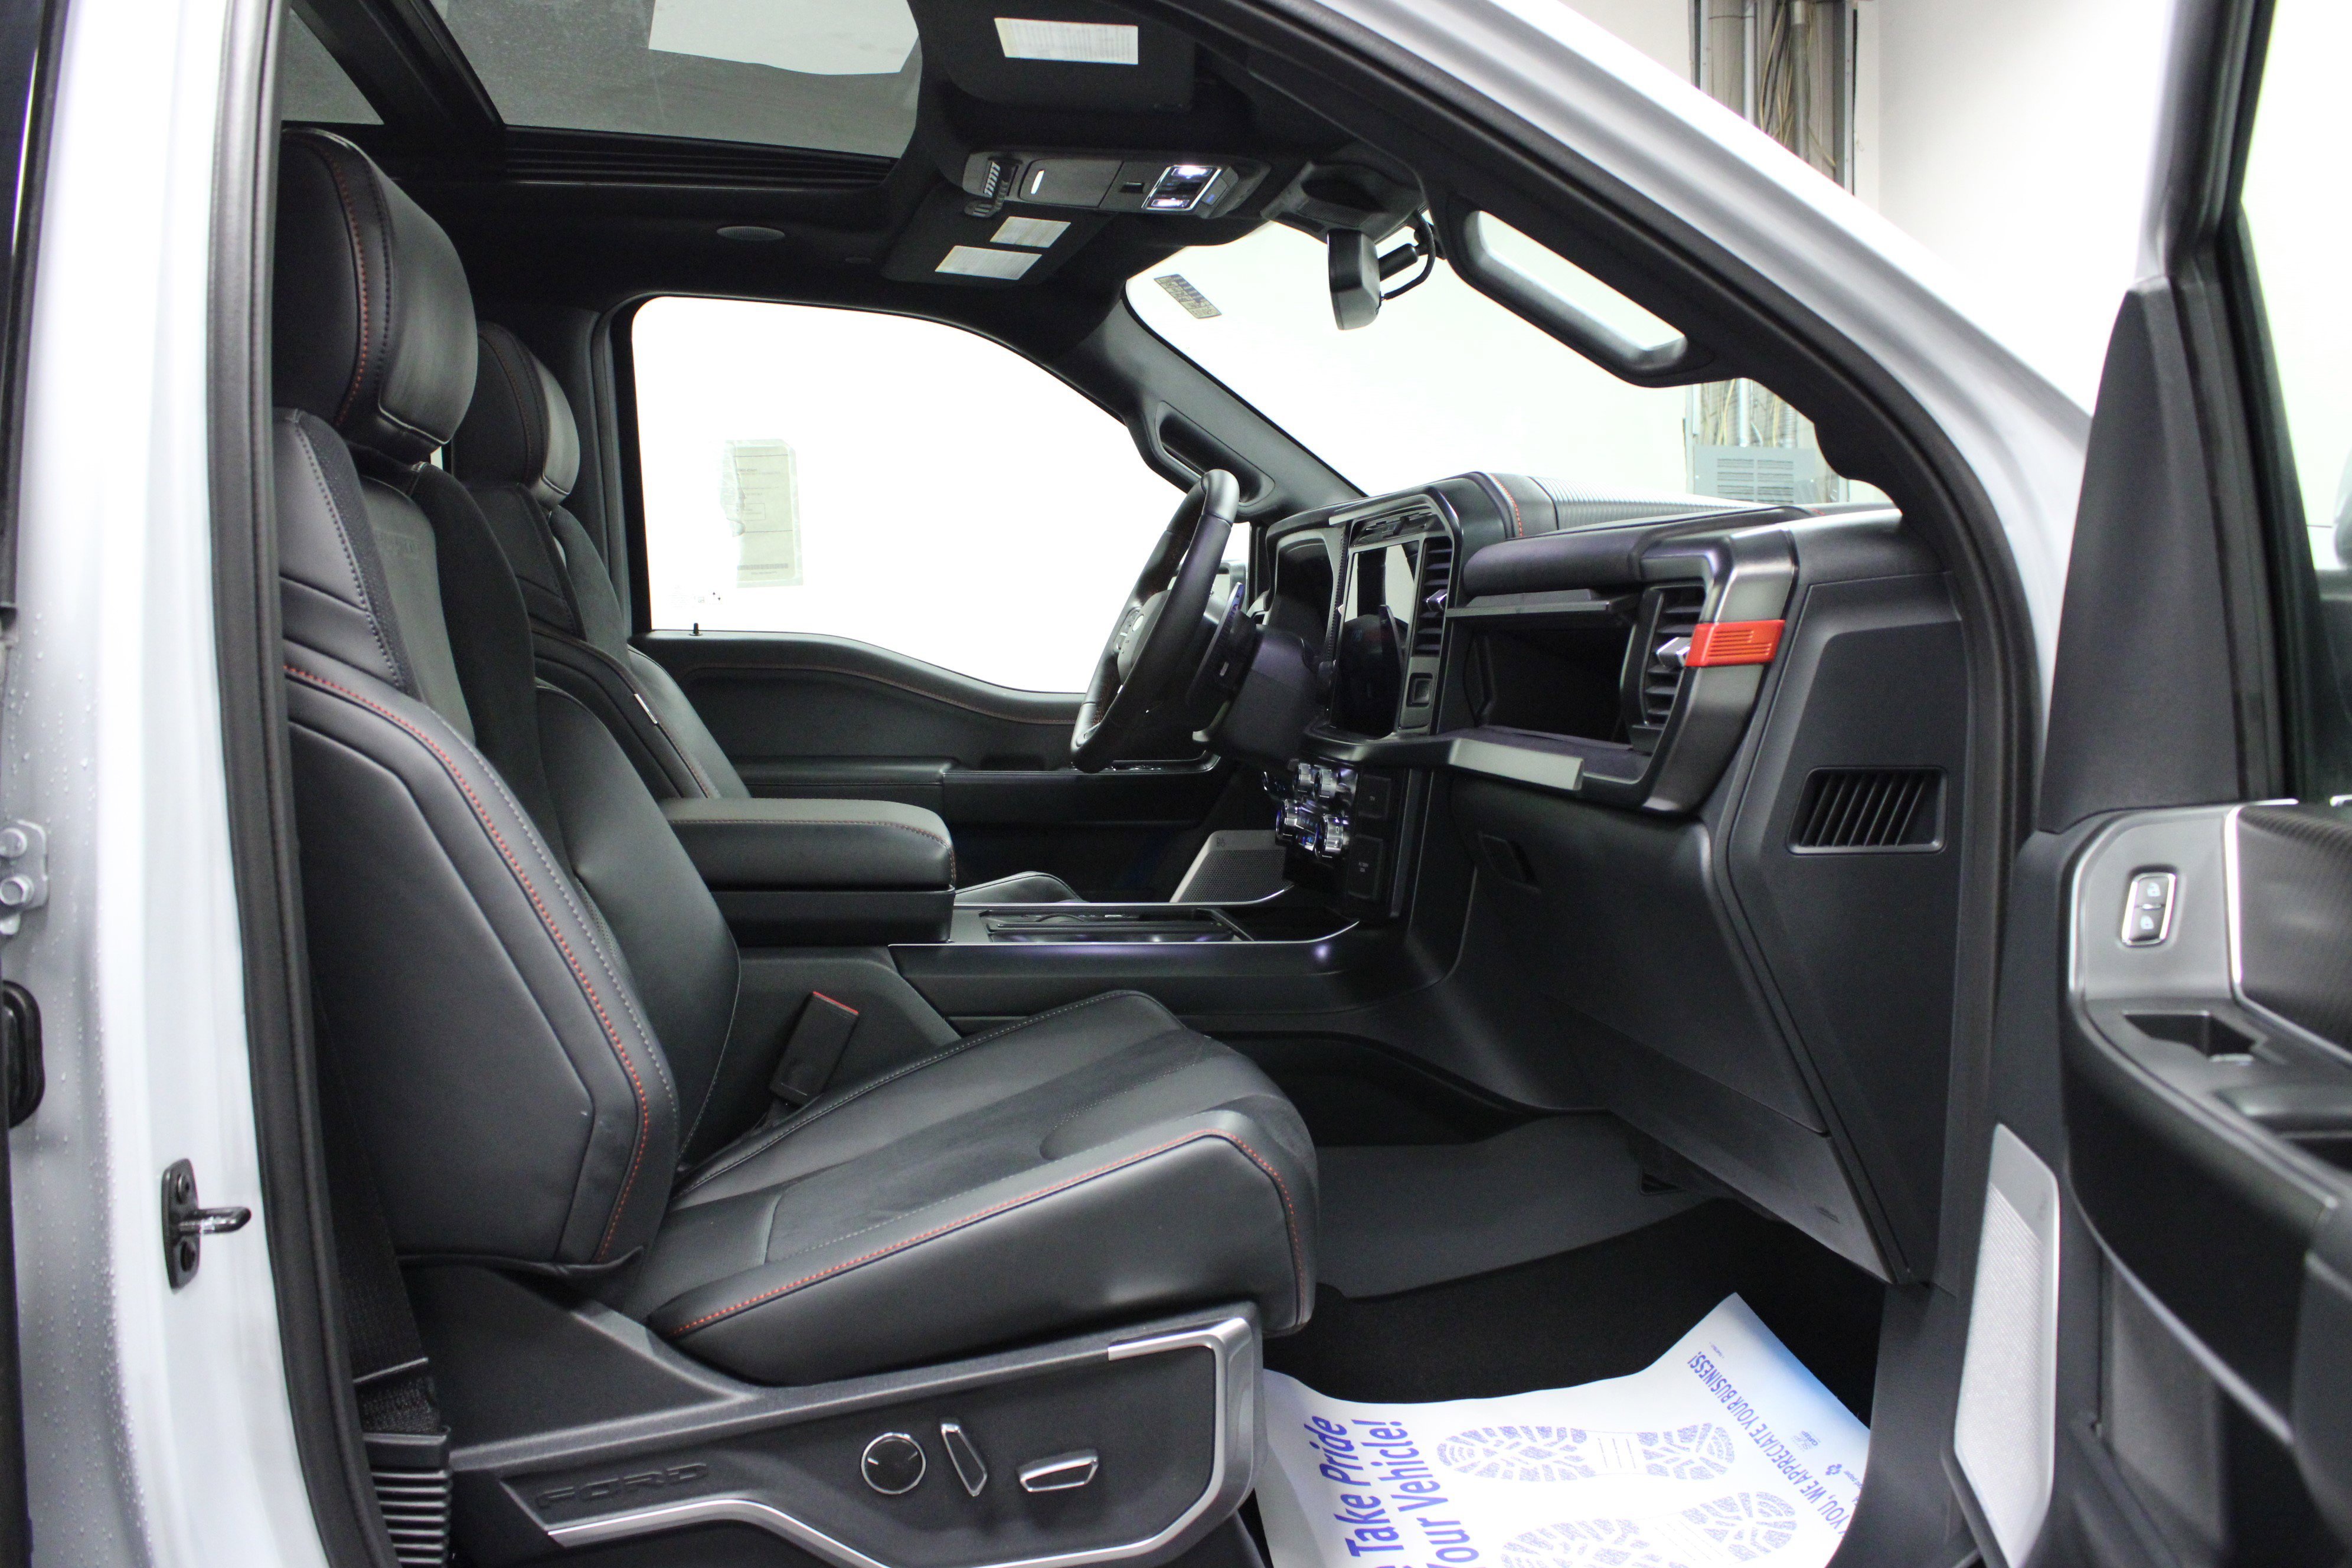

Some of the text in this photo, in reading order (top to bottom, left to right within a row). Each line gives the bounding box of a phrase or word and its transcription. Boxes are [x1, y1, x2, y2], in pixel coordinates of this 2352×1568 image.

[1687, 1351, 1737, 1403] BUSINESS!
[1727, 1396, 1759, 1430] YOUR
[1801, 1430, 1818, 1446] GRIP
[1304, 1415, 1371, 1487] Pride
[1351, 1419, 1449, 1512] Vehicle!
[1749, 1423, 1812, 1485] APPRECIATE
[535, 1462, 707, 1507] FORD
[1800, 1480, 1827, 1504] WE
[1334, 1494, 1404, 1557] Take
[1817, 1494, 1850, 1529] YOU,
[1416, 1517, 1486, 1568] our
